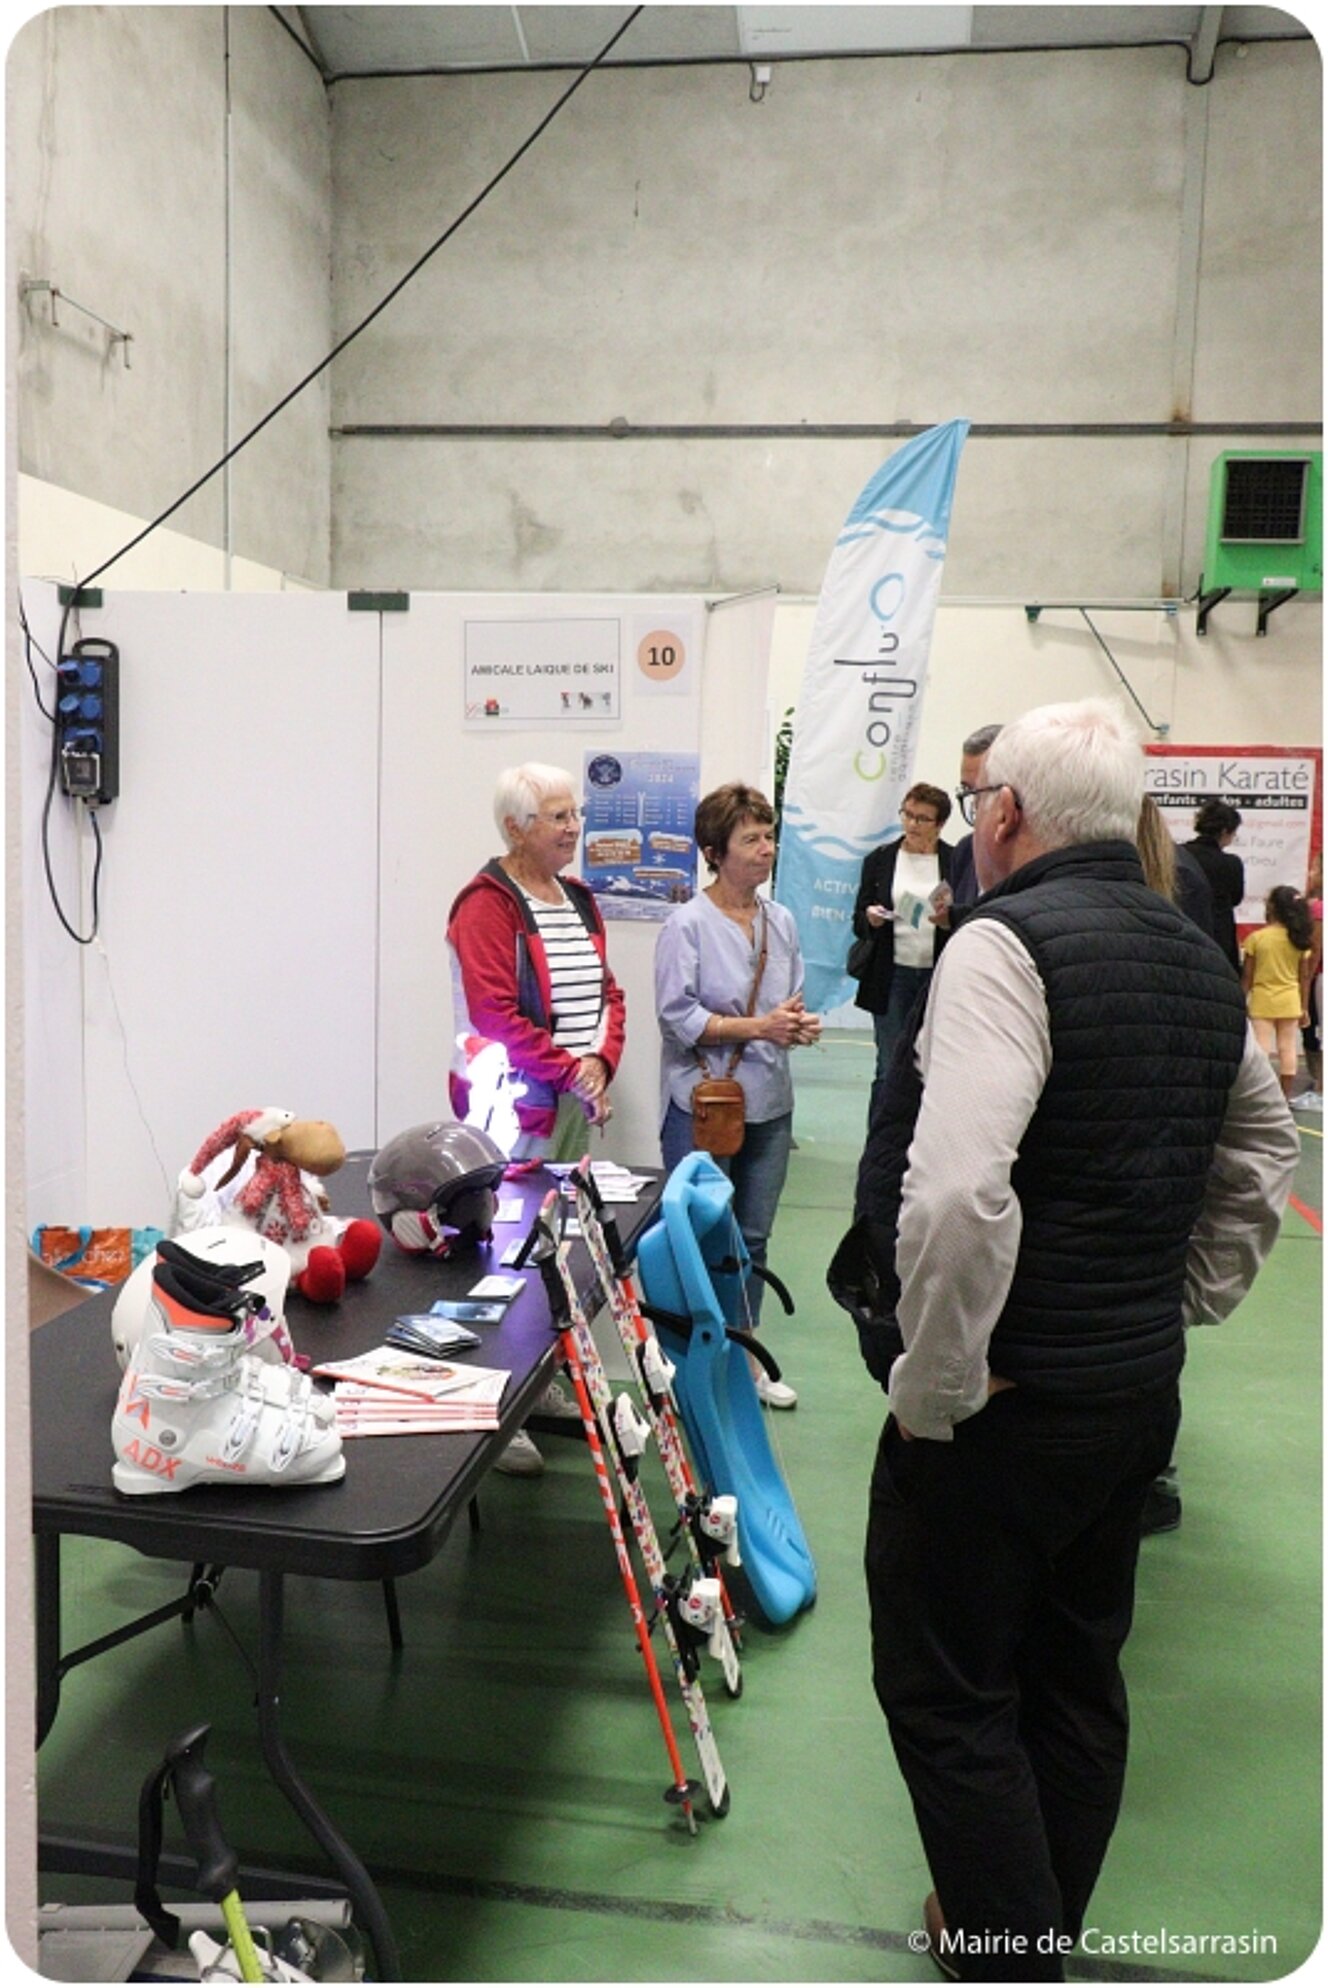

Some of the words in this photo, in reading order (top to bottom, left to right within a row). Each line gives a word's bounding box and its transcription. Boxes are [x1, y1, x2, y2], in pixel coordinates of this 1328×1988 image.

[647, 646, 676, 666] 10
[471, 664, 524, 676] AMICALE
[574, 663, 590, 674] DE
[593, 663, 614, 674] SKI
[1145, 762, 1208, 789] rasin
[1218, 760, 1309, 790] Karaté
[1255, 795, 1305, 808] adultes
[814, 877, 859, 894] ACTIV
[122, 1438, 182, 1481] ADX
